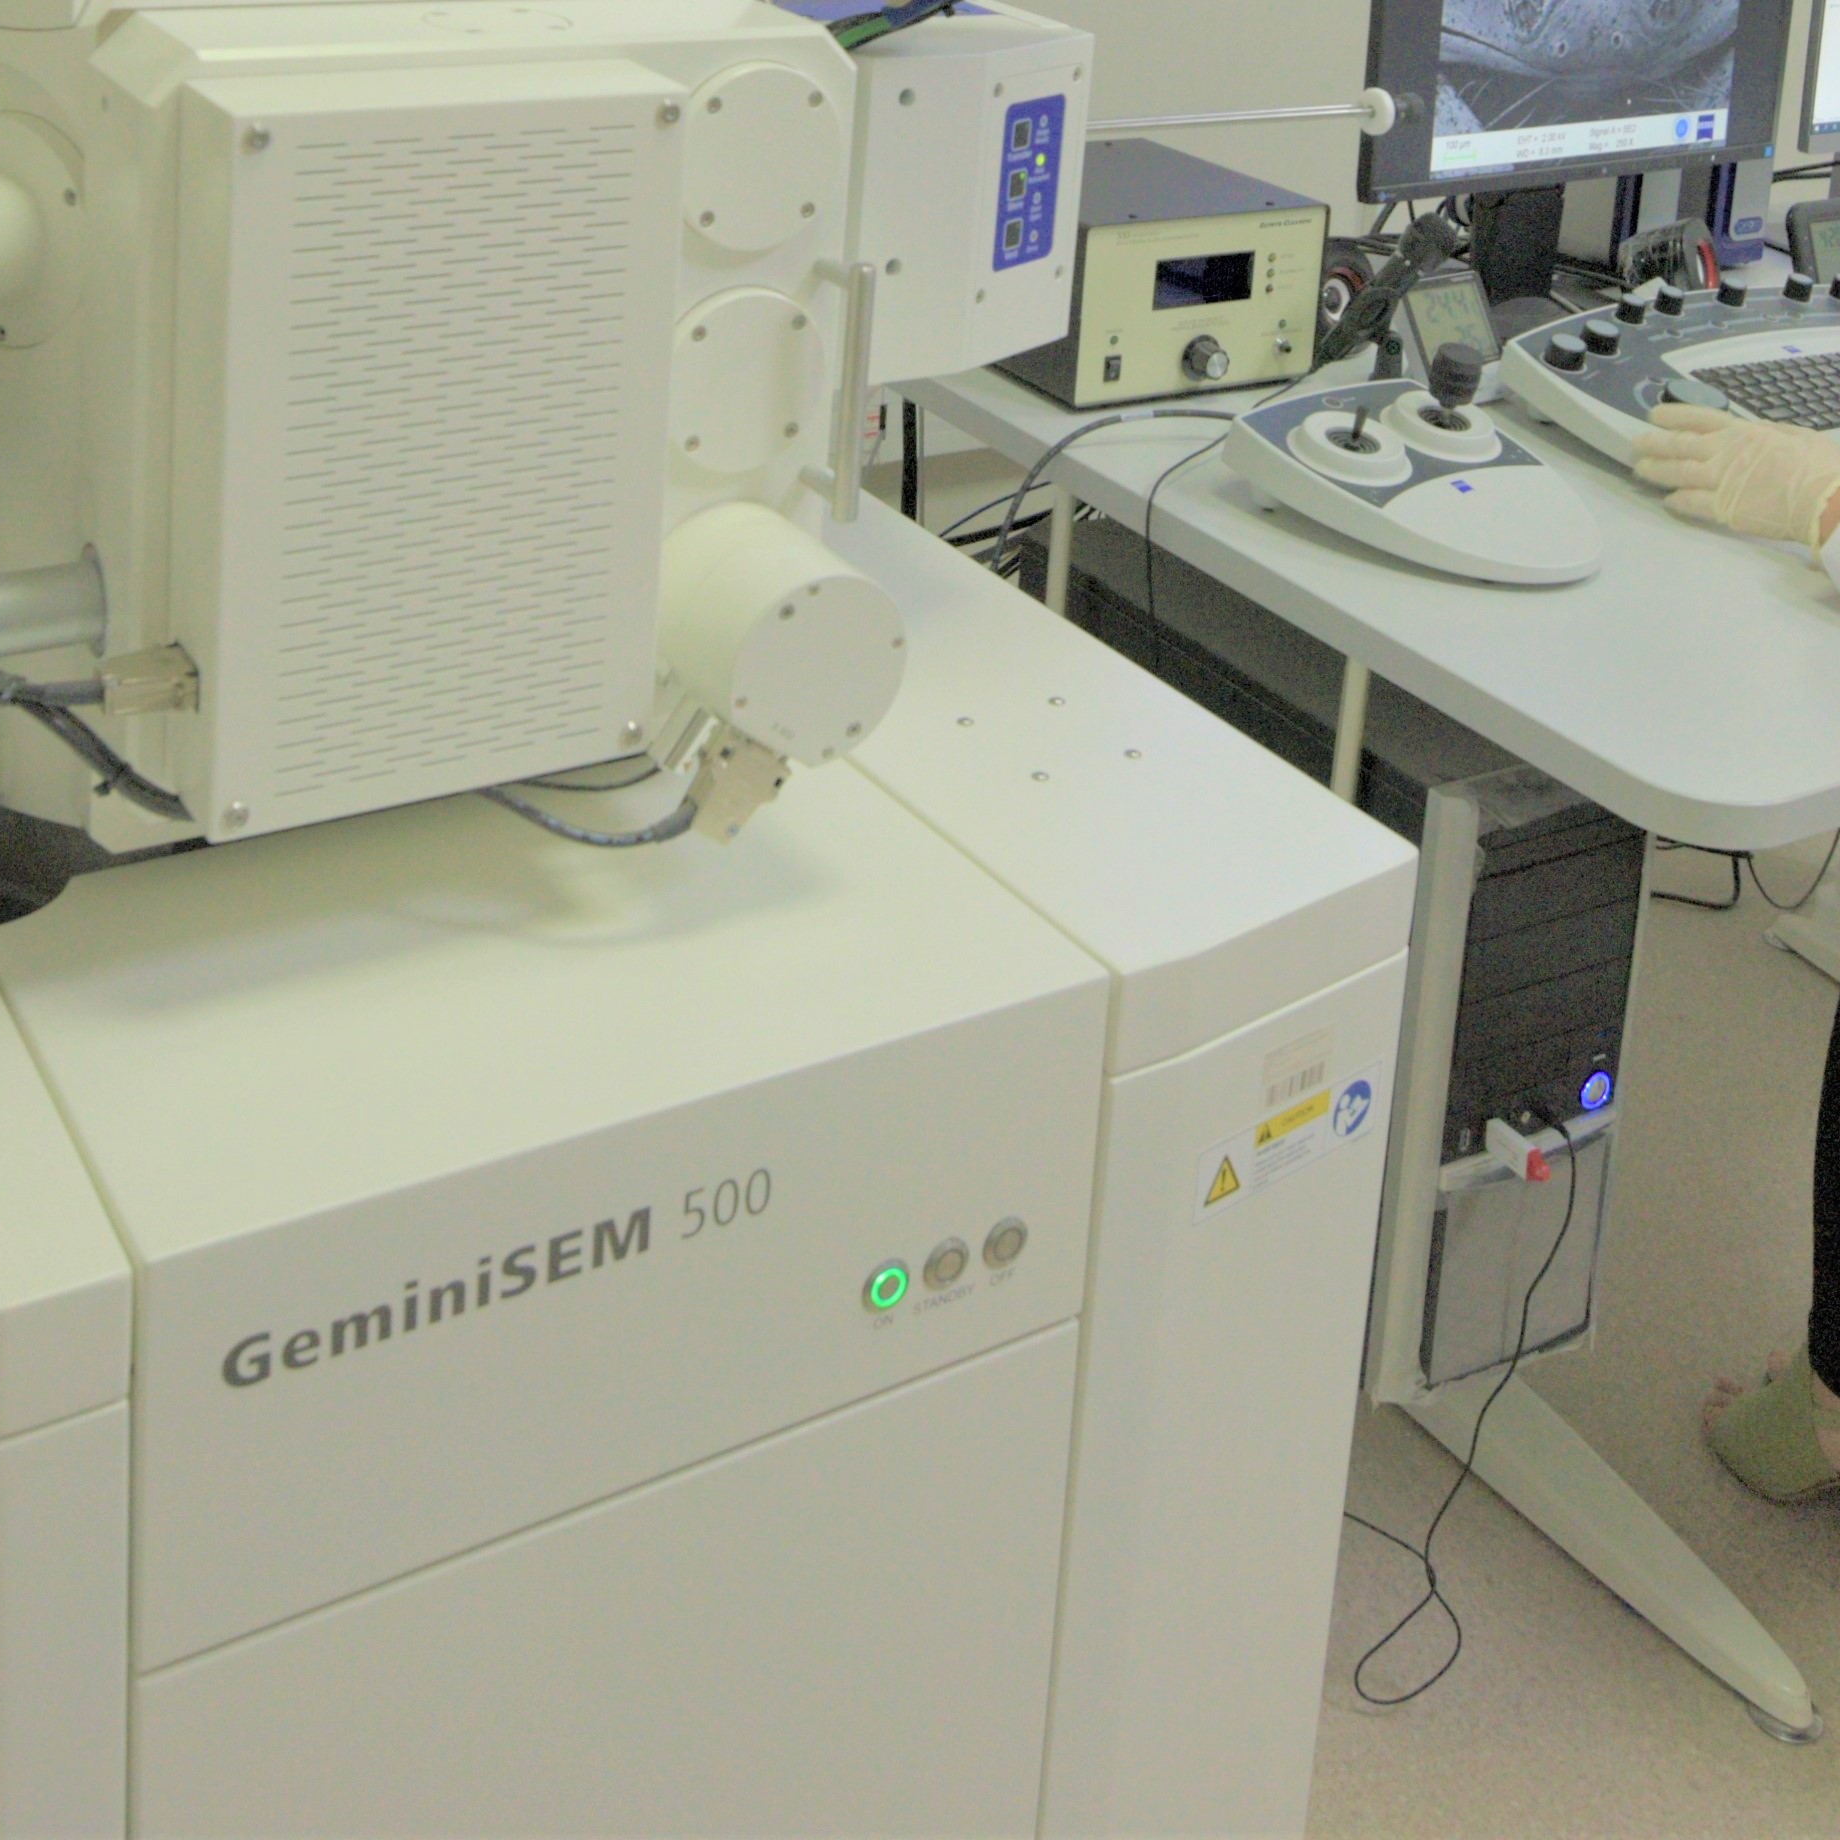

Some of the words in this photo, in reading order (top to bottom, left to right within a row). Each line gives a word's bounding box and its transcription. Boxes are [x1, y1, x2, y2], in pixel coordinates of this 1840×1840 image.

[221, 1206, 653, 1388] GeminiSEM
[680, 1168, 773, 1240] 500
[989, 1267, 1017, 1287] OFF
[912, 1282, 976, 1317] STANDBY
